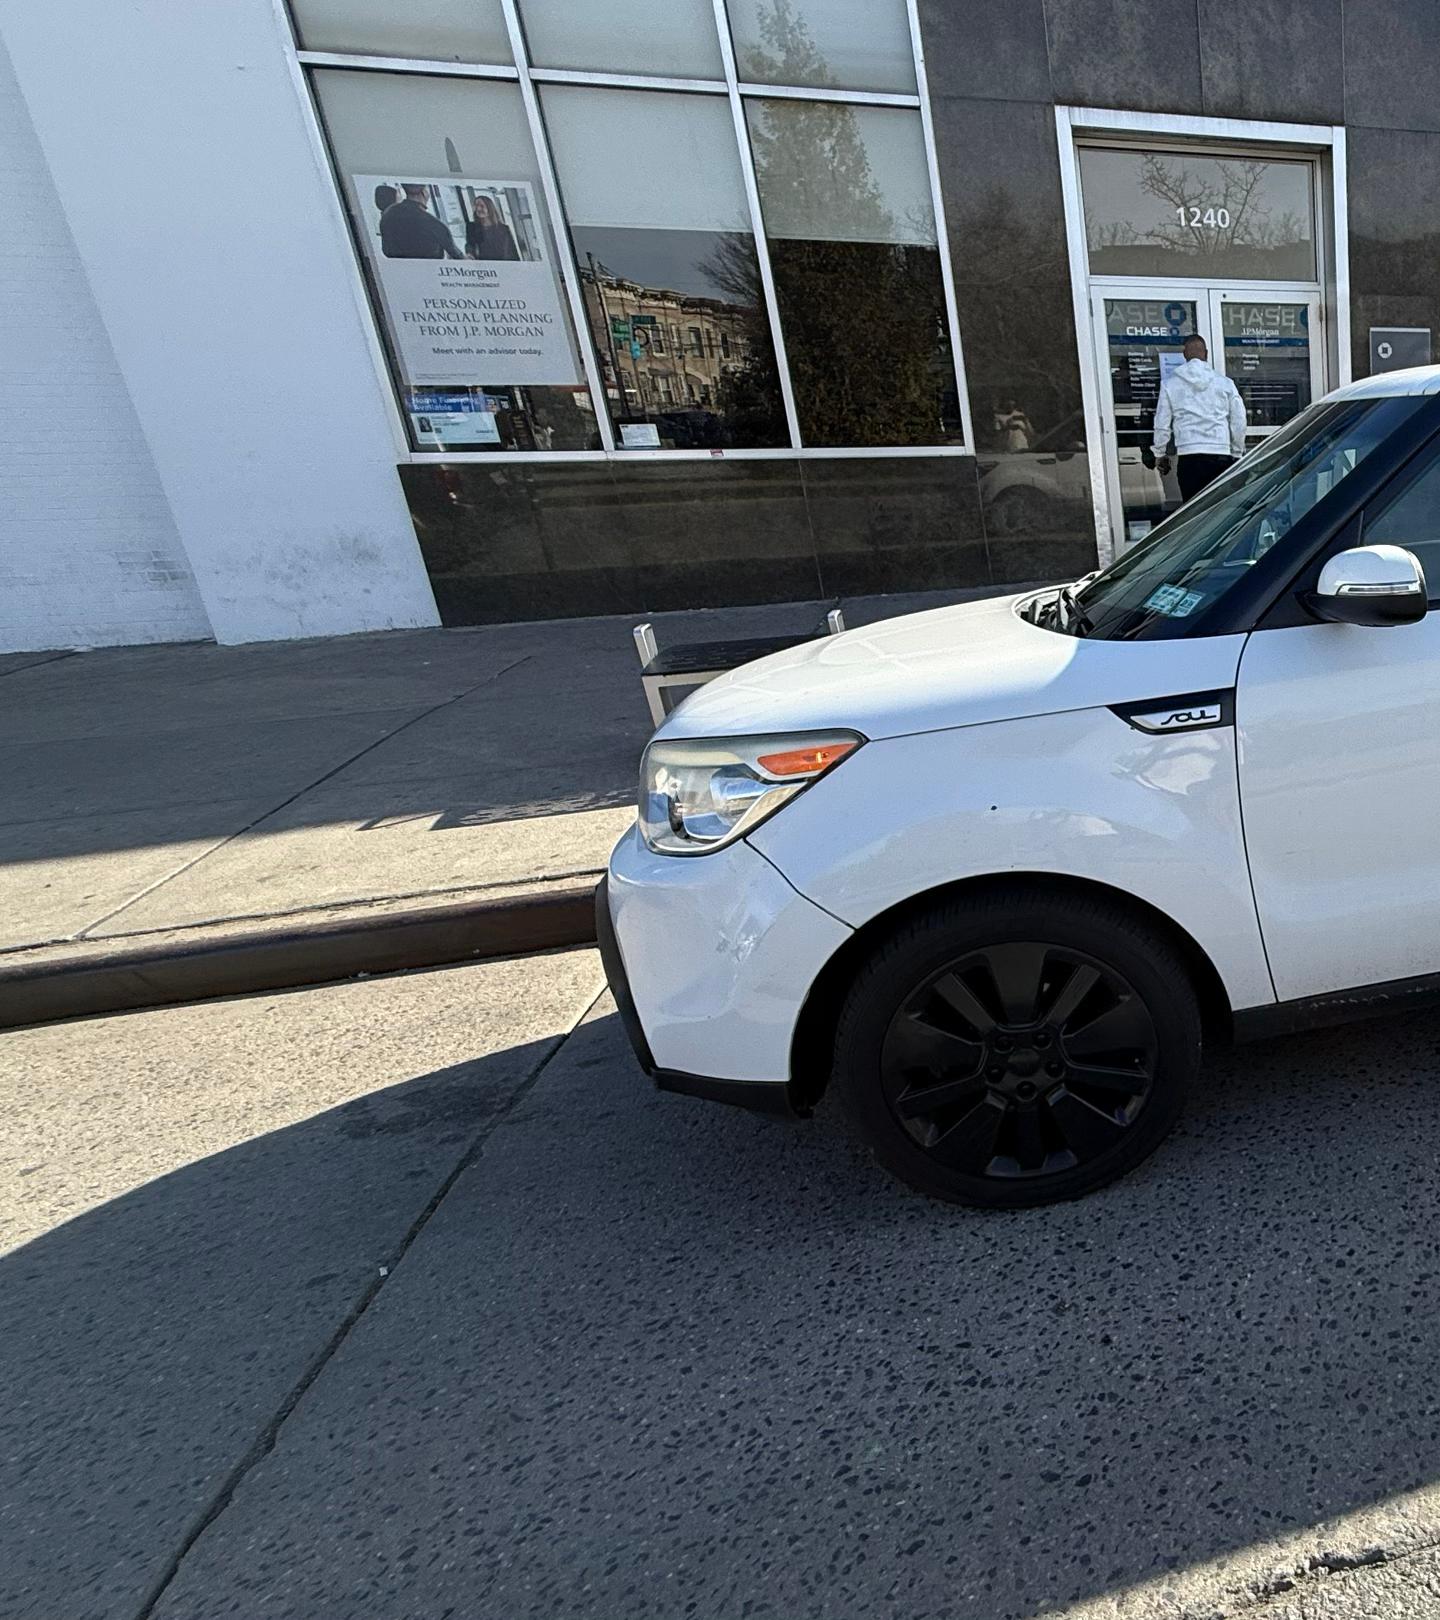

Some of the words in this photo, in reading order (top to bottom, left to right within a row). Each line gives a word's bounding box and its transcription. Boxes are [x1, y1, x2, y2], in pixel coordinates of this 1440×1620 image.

[1176, 207, 1230, 228] 1240
[424, 298, 526, 310] PERSONALIZED
[402, 312, 480, 323] FINANCIAL
[483, 313, 553, 324] PLANNING
[420, 325, 459, 336] FROM
[464, 326, 481, 339] J.P.
[485, 326, 545, 337] MORGAN
[1126, 326, 1168, 336] CHASE
[432, 347, 453, 355] Meet
[456, 347, 474, 355] with
[489, 347, 517, 355] advisor
[519, 347, 544, 356] today.
[1161, 710, 1217, 725] SOUL
